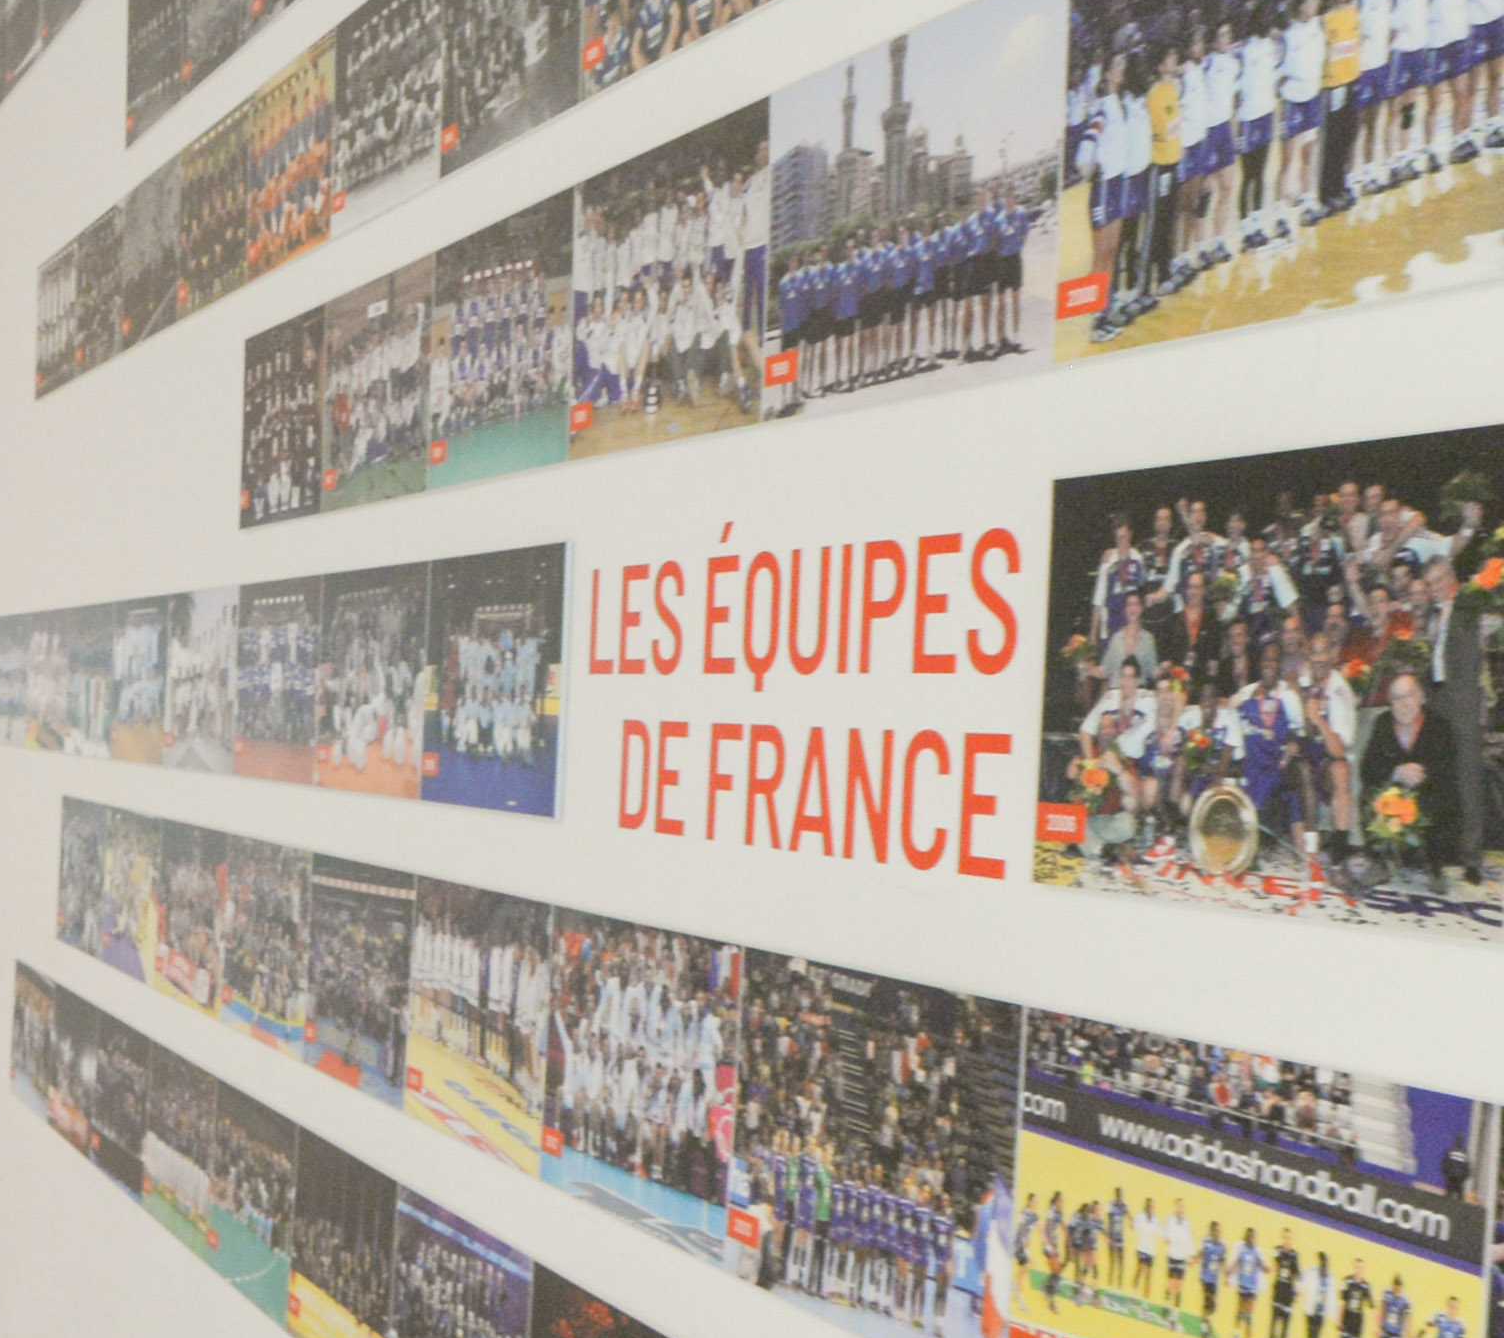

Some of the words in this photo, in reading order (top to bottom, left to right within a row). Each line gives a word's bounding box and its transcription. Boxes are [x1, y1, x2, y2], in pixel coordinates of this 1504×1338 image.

[589, 560, 685, 676] LES
[704, 521, 1021, 692] ÉQUIPES
[619, 719, 690, 837] DE
[706, 723, 1013, 880] FRANCE
[1046, 814, 1076, 832] 2006
[1098, 1113, 1450, 1242] www.adidashandball.com
